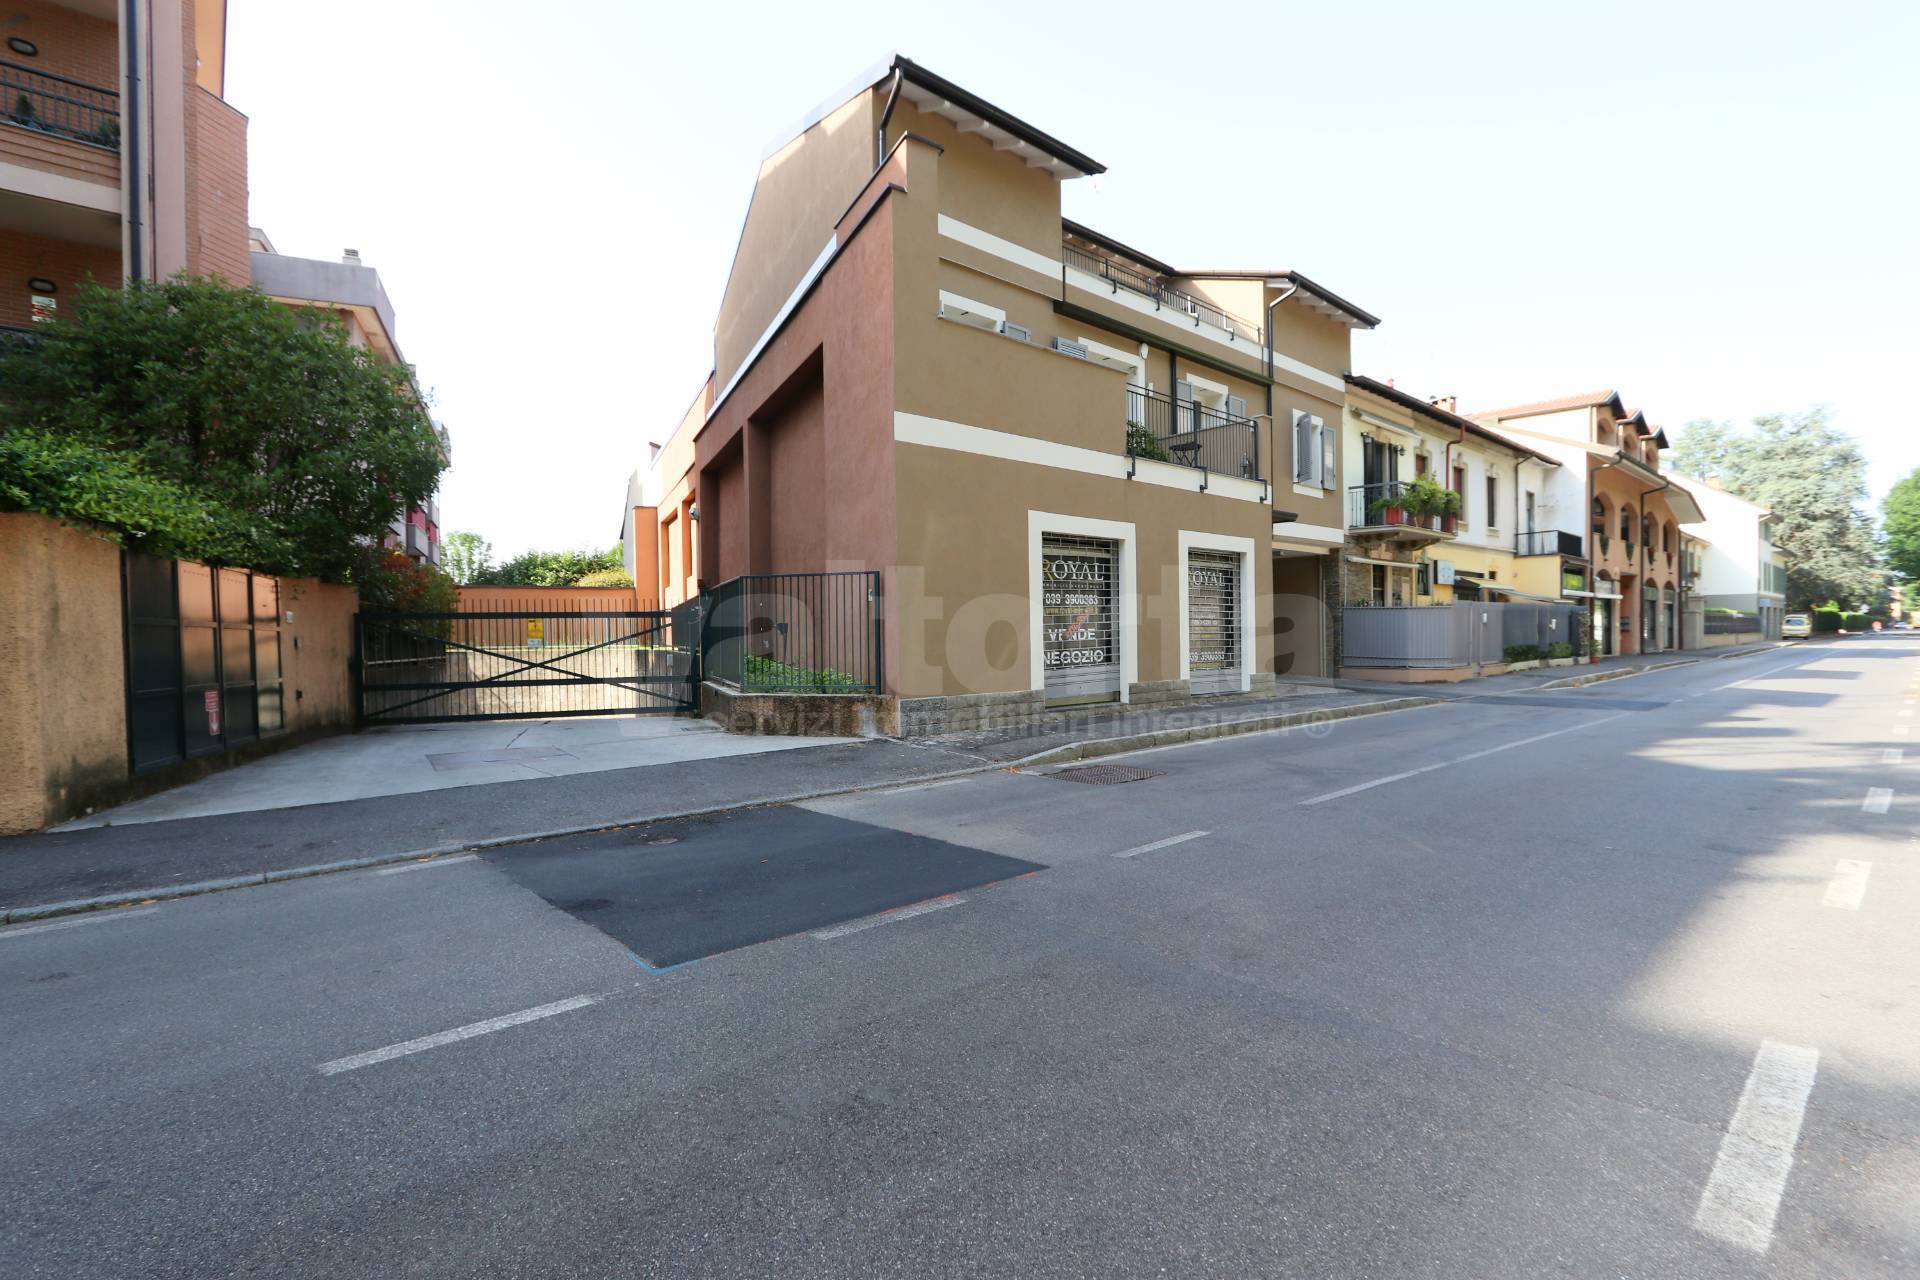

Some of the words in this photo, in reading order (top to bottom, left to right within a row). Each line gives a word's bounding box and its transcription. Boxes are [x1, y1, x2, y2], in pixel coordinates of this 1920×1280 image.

[1042, 559, 1104, 581] ROYAL
[1188, 570, 1226, 587] OYAL
[1045, 593, 1061, 605] 039
[1043, 649, 1104, 665] NEGOZIO
